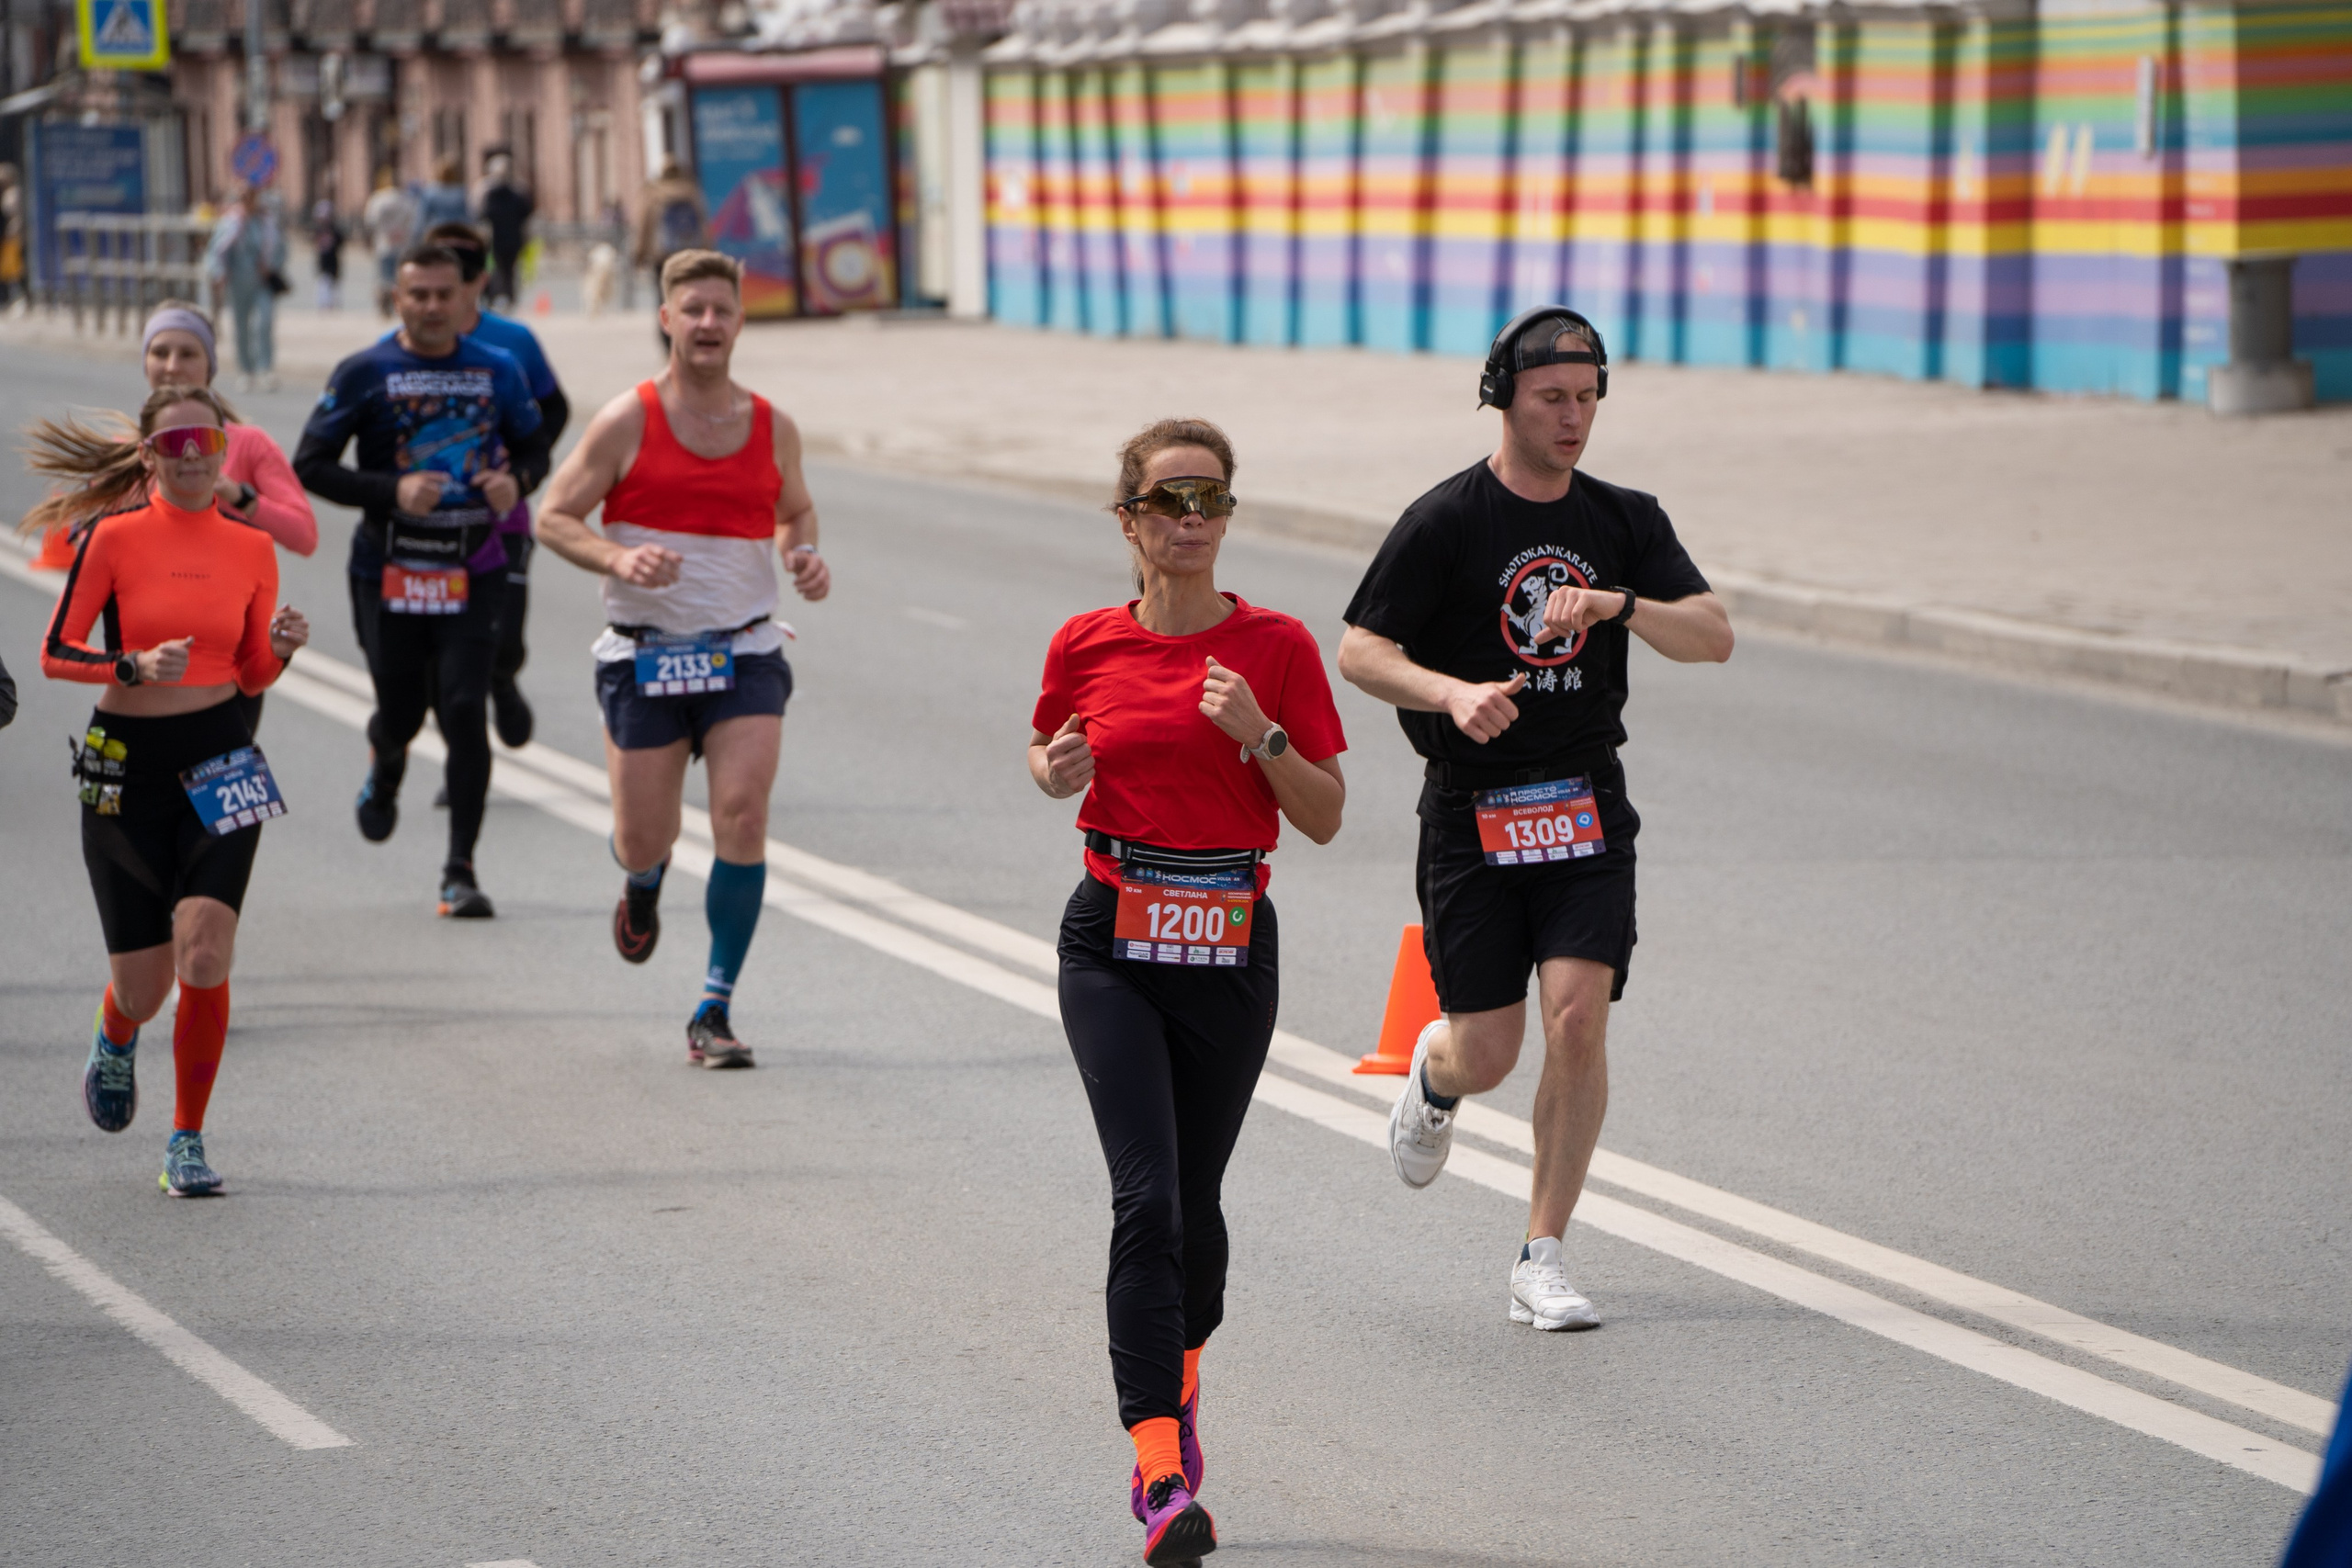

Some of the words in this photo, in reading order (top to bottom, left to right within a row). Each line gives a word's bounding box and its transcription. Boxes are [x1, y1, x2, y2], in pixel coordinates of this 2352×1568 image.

[656, 652, 713, 682] 2133
[216, 773, 269, 815] 2143
[1518, 785, 1557, 796] ПРОСТО
[1510, 792, 1558, 804] КОСМОС
[1513, 805, 1555, 817] ВСЕВОЛОД
[1504, 814, 1575, 848] 1309
[1162, 874, 1217, 885] КОСМОС
[1163, 888, 1208, 899] СВЕТЛАНА
[1147, 902, 1226, 942] 1200
